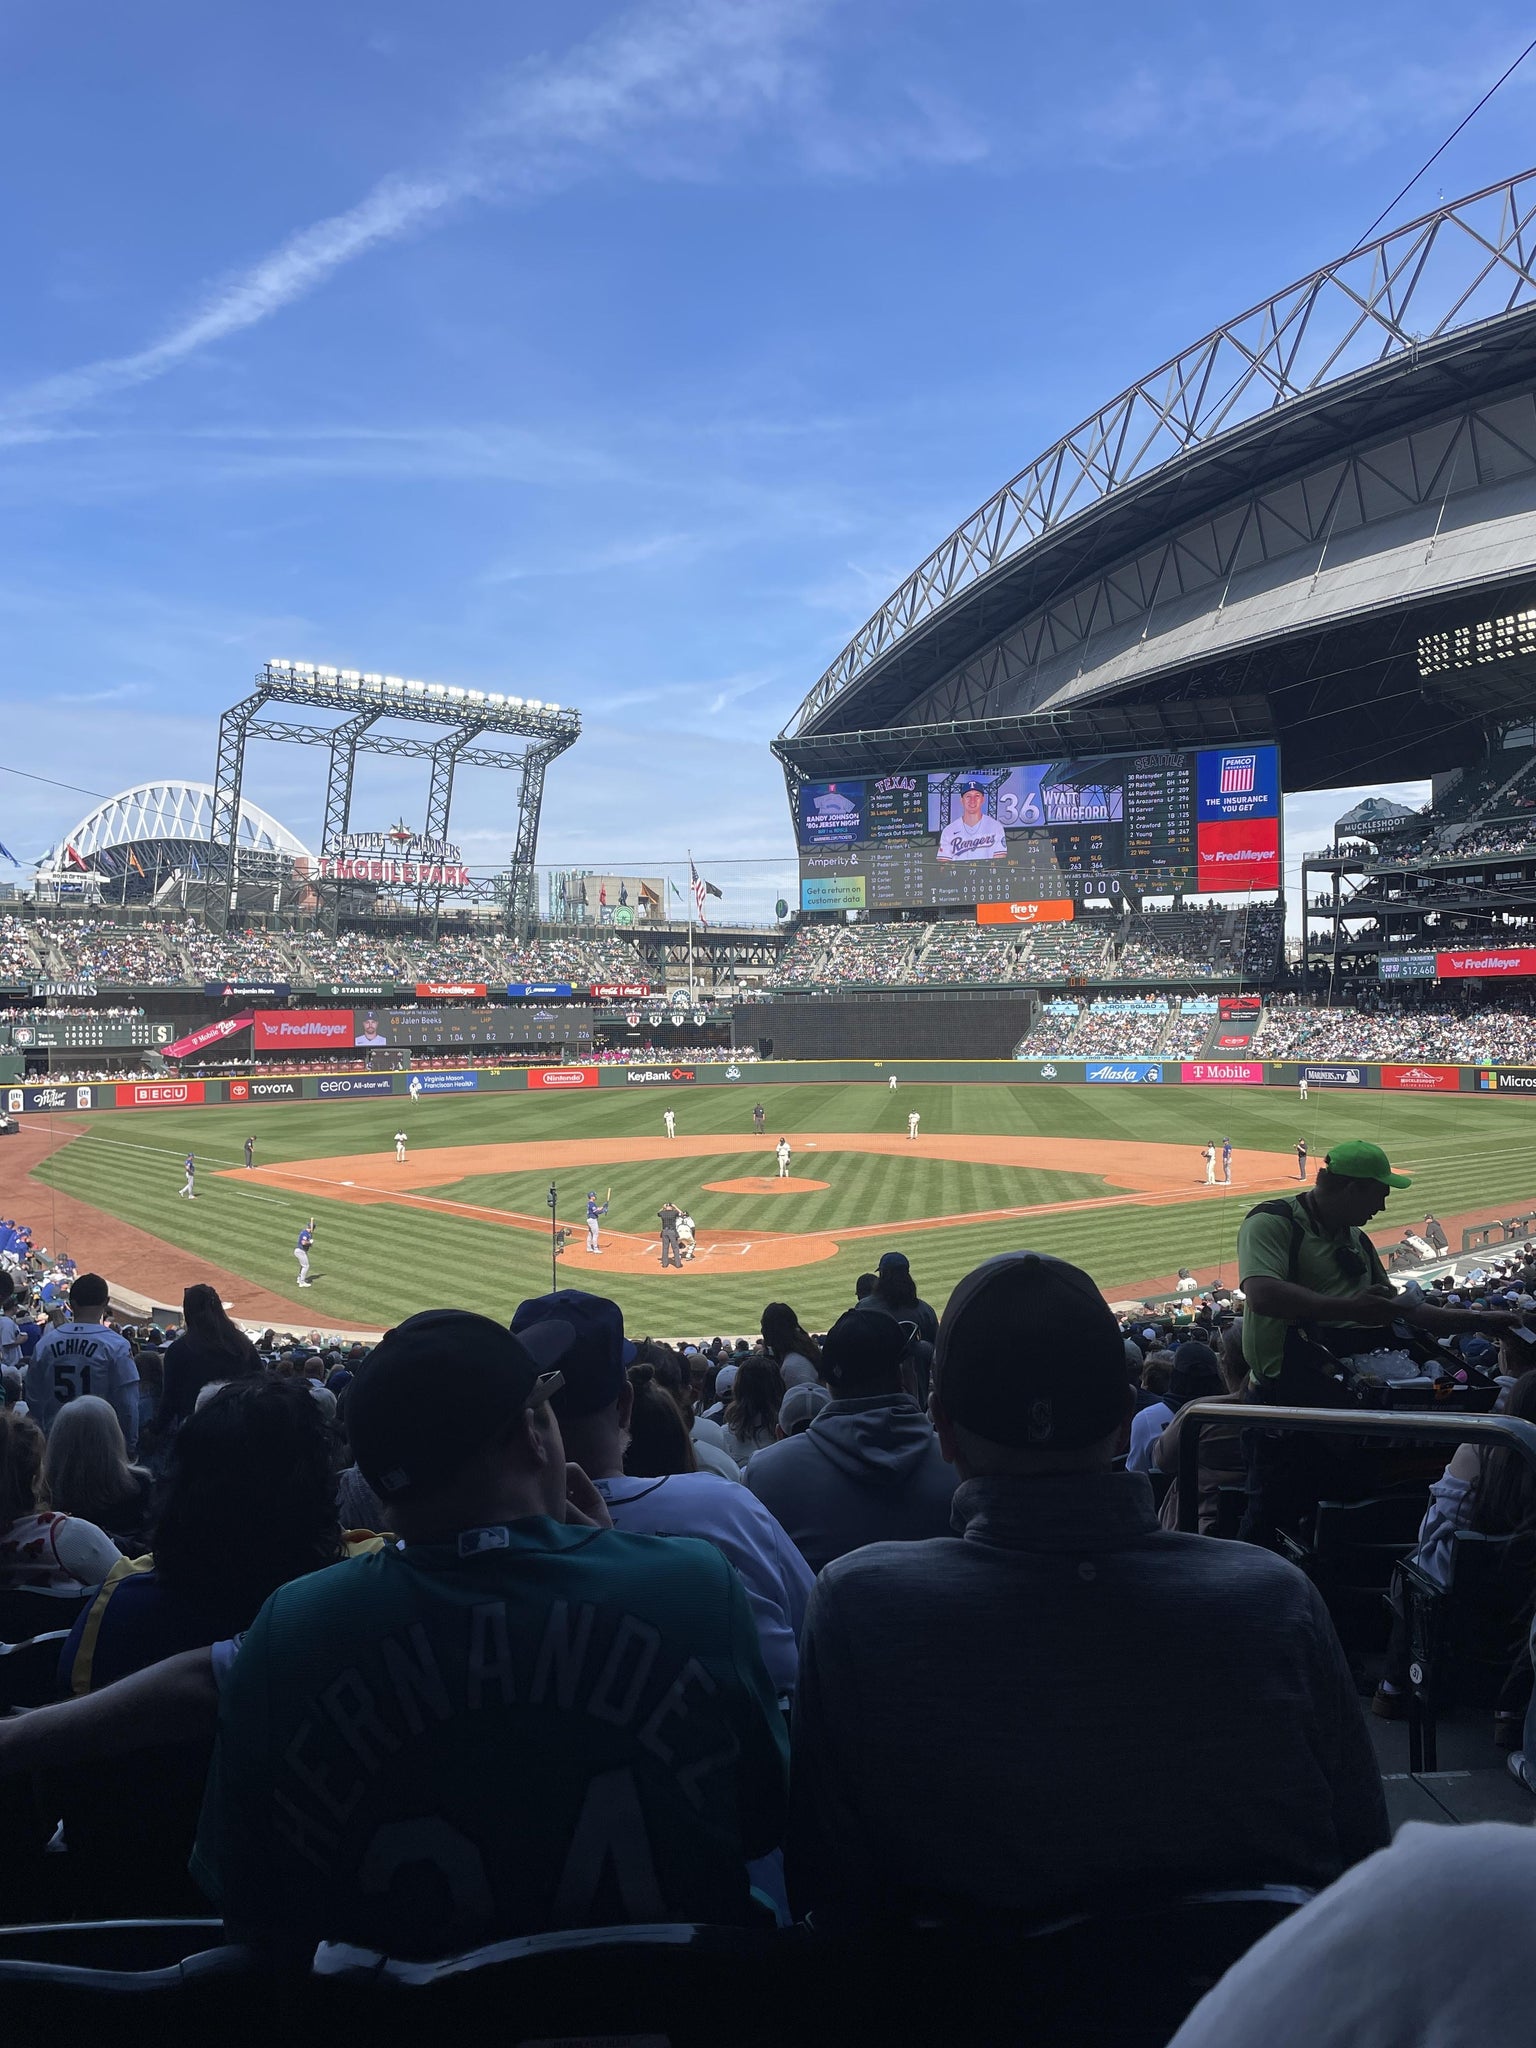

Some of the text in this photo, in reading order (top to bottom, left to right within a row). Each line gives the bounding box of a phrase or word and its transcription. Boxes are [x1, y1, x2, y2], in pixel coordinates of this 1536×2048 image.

[1134, 753, 1185, 771] SEATTLE
[1225, 758, 1252, 766] PEMCO
[875, 776, 917, 793] TEXAS
[968, 781, 976, 789] T
[1042, 790, 1079, 805] WYATT
[1206, 795, 1268, 806] THE INSURANCE
[1000, 793, 1040, 825] 36
[1047, 805, 1109, 821] LANGFORD
[1344, 817, 1406, 832] MUCKLESHOOT
[332, 832, 462, 860] SEATTLE MARINERS
[951, 834, 995, 855] Rangers
[807, 856, 849, 868] Amperity
[418, 862, 470, 887] PARK
[807, 887, 821, 895] Get
[827, 886, 851, 894] return
[807, 895, 861, 905] customer data
[1010, 904, 1039, 914] fire tv
[1402, 965, 1435, 975] $12,460
[33, 983, 98, 997] EDGARS
[233, 987, 275, 995] Benjamin Moore
[390, 1017, 400, 1025] 68
[400, 1017, 419, 1025] Jalen
[157, 1026, 168, 1042] S
[198, 1029, 219, 1042] Mobile
[450, 1033, 463, 1041] 1.04
[546, 1073, 581, 1083] Nintendo
[628, 1070, 671, 1082] KeyBank
[1090, 1065, 1137, 1081] Alaska
[1193, 1065, 1250, 1079] T Mobile
[320, 1081, 351, 1092] eero
[353, 1080, 376, 1089] All-star
[424, 1076, 445, 1084] Virginia
[454, 1080, 474, 1088] Health
[79, 1089, 90, 1099] Lite
[252, 1084, 294, 1095] TOYOTA
[11, 1092, 22, 1100] Lite
[33, 1092, 67, 1107] Miller
[51, 1338, 99, 1359] ICHIRO
[54, 1365, 91, 1400] 51
[1028, 1399, 1055, 1443] S
